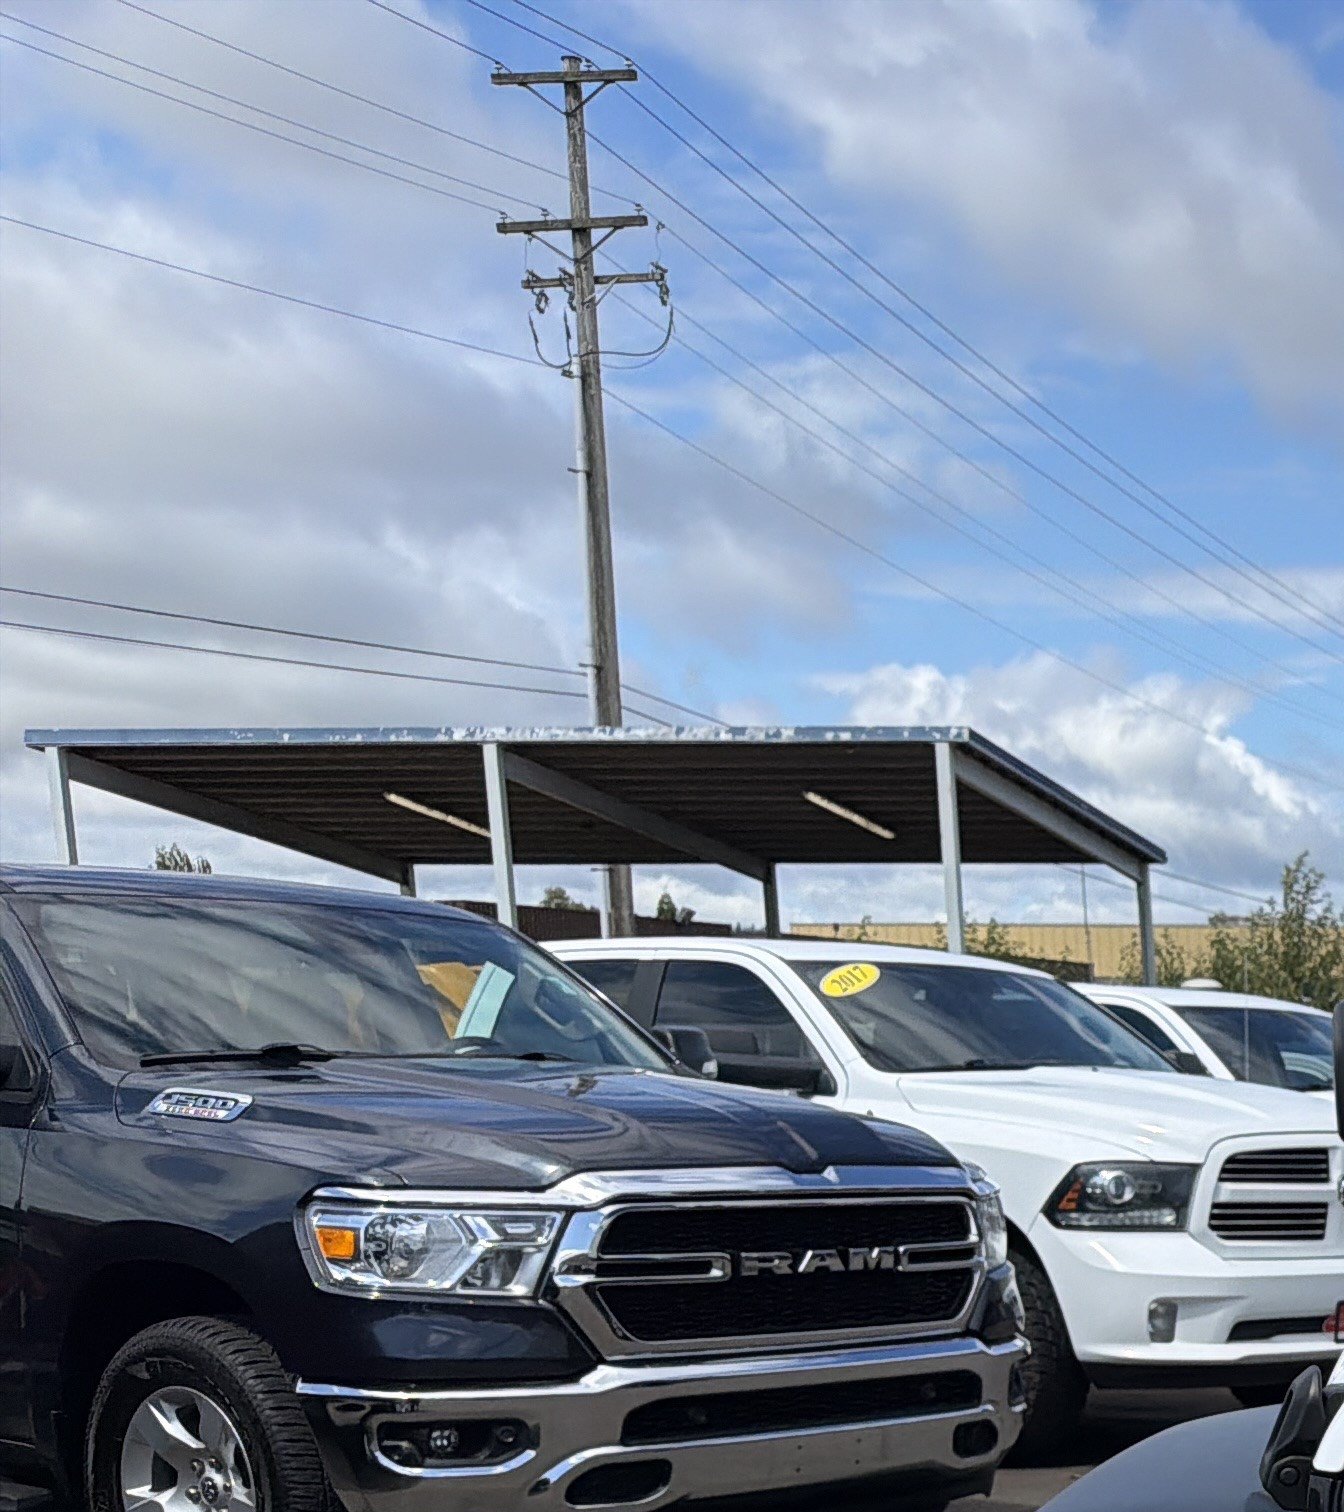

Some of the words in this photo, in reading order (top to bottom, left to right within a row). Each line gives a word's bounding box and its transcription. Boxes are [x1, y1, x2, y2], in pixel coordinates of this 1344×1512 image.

[831, 965, 868, 993] 2017
[162, 1094, 236, 1111] 1500
[740, 1246, 895, 1277] RAM
